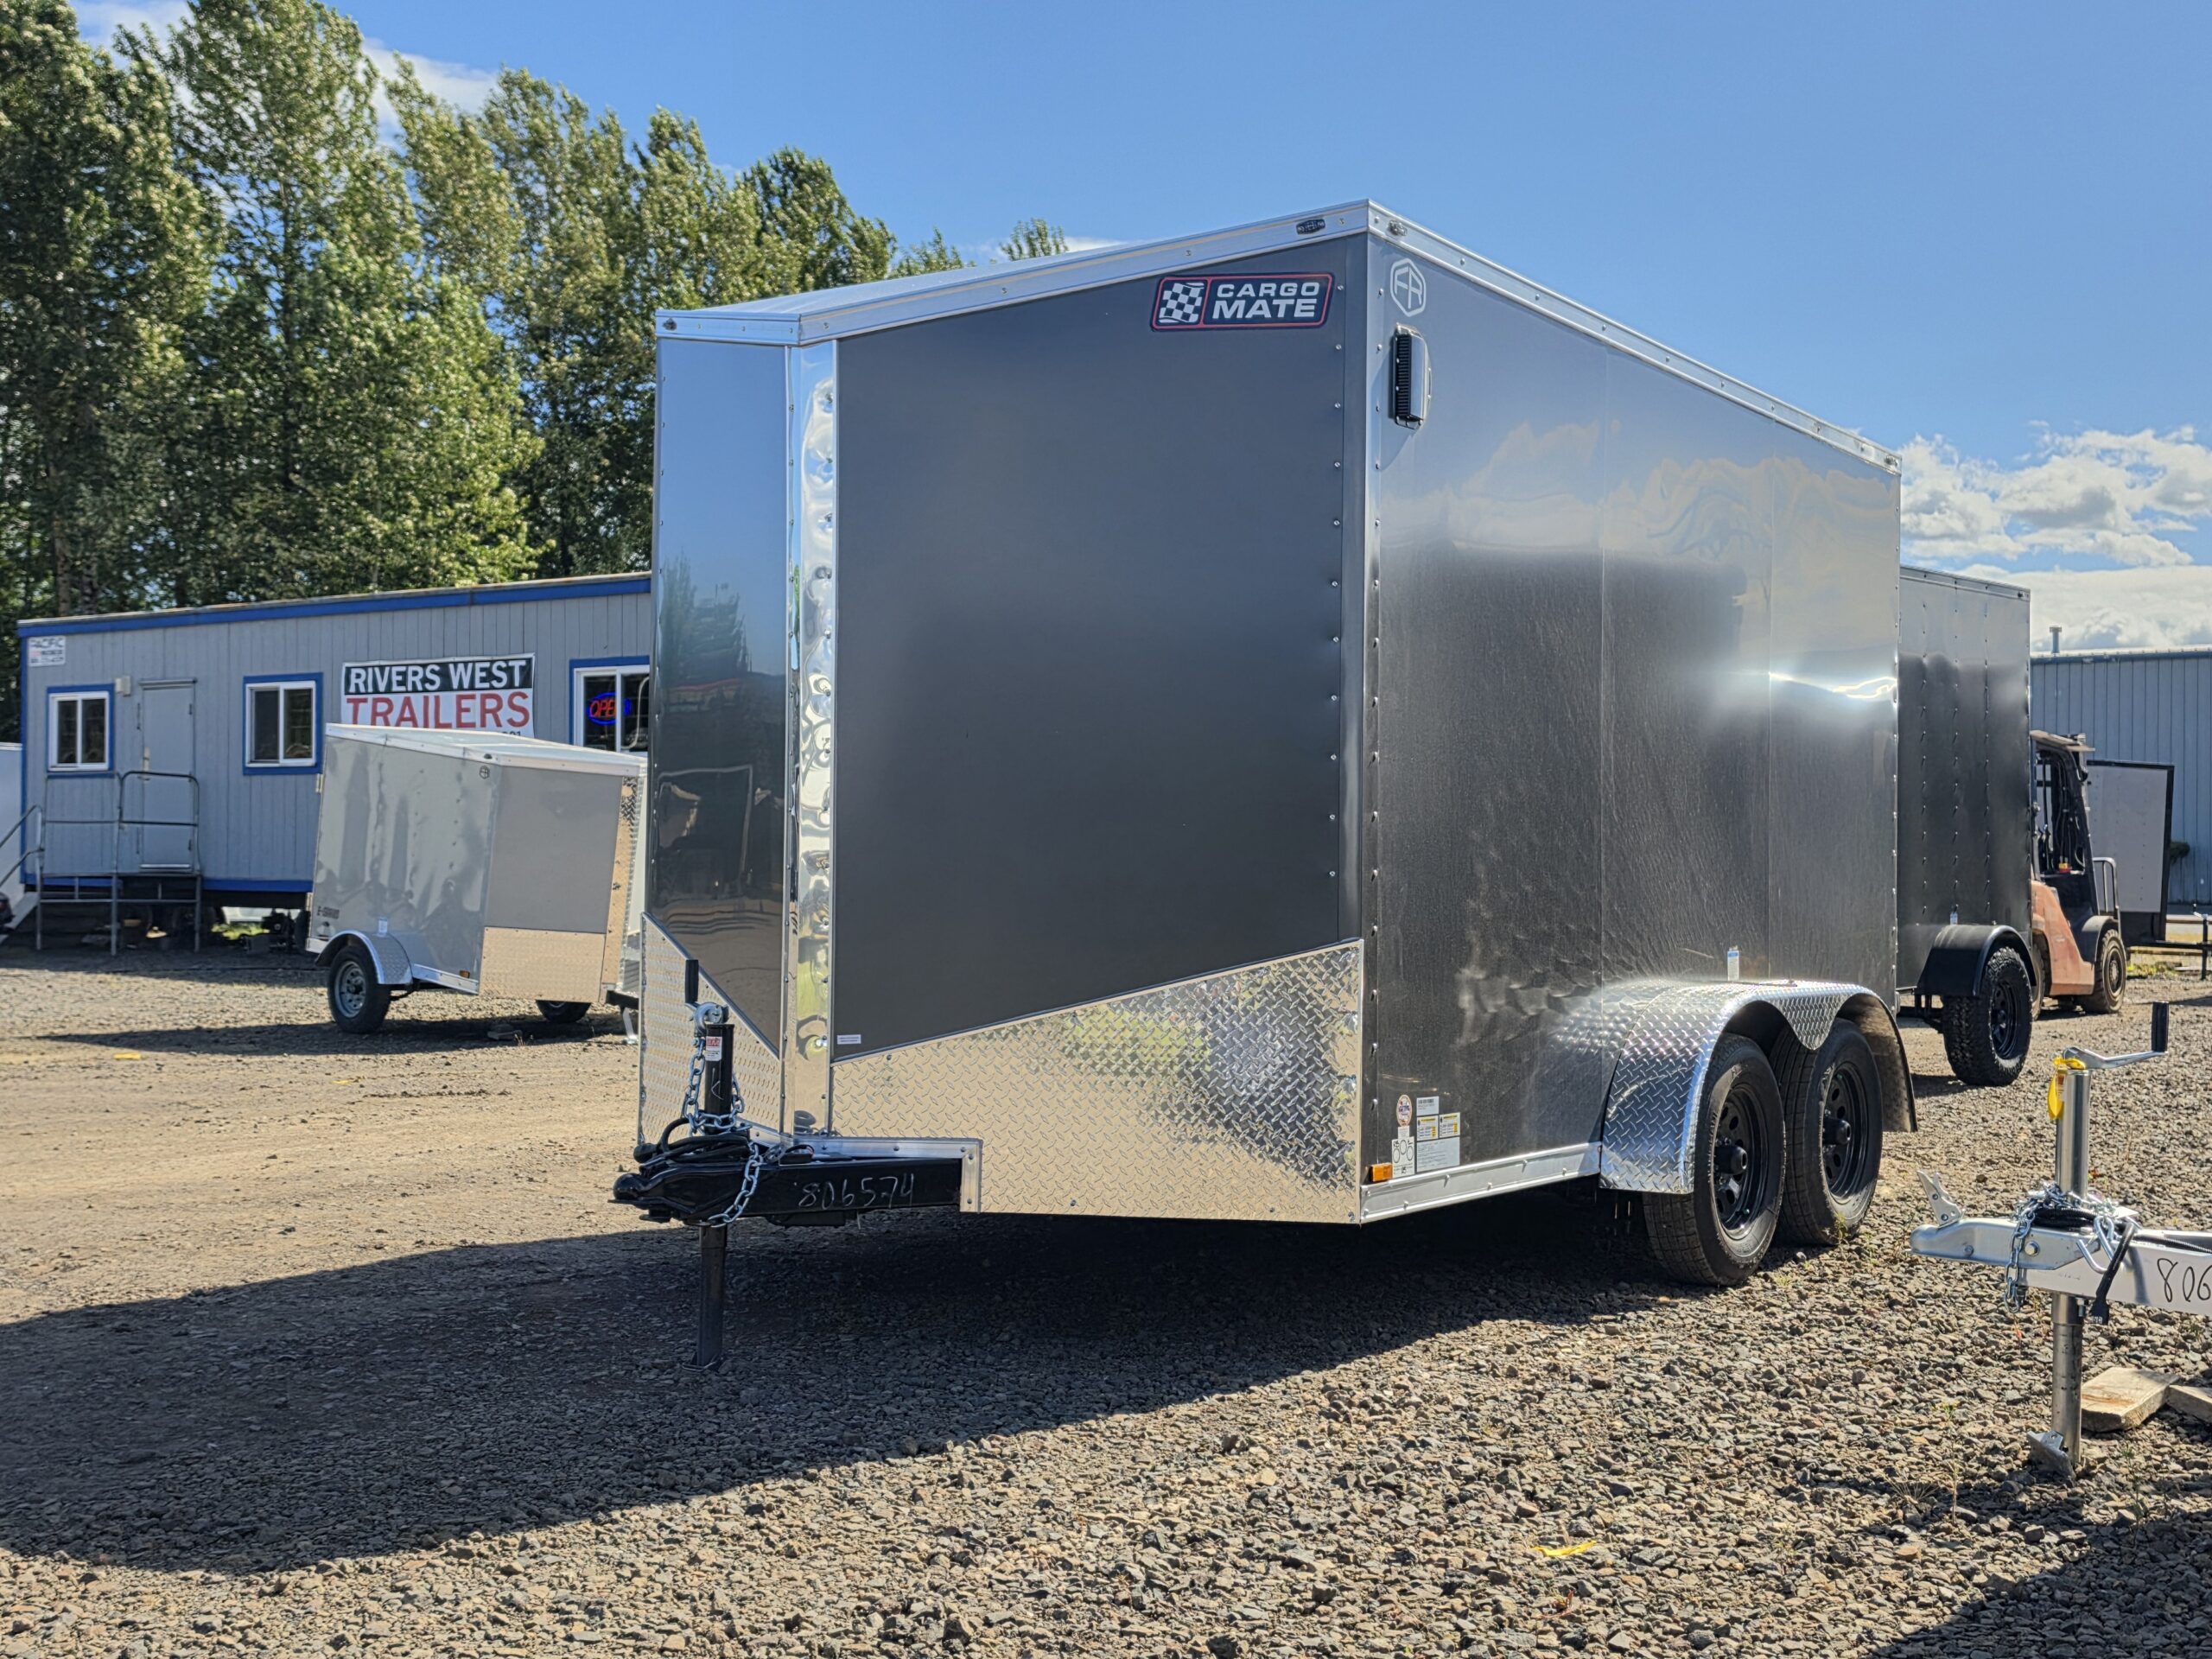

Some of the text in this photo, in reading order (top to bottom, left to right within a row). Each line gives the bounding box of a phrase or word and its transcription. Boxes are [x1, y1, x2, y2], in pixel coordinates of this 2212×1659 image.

[1217, 282, 1320, 298] CARGO
[1212, 298, 1318, 319] MATE
[349, 660, 526, 692] RIVERS WEST
[346, 690, 531, 729] TRAILERS
[589, 698, 619, 718] OPE
[798, 1173, 916, 1210] 806574
[2157, 1257, 2212, 1304] 806
